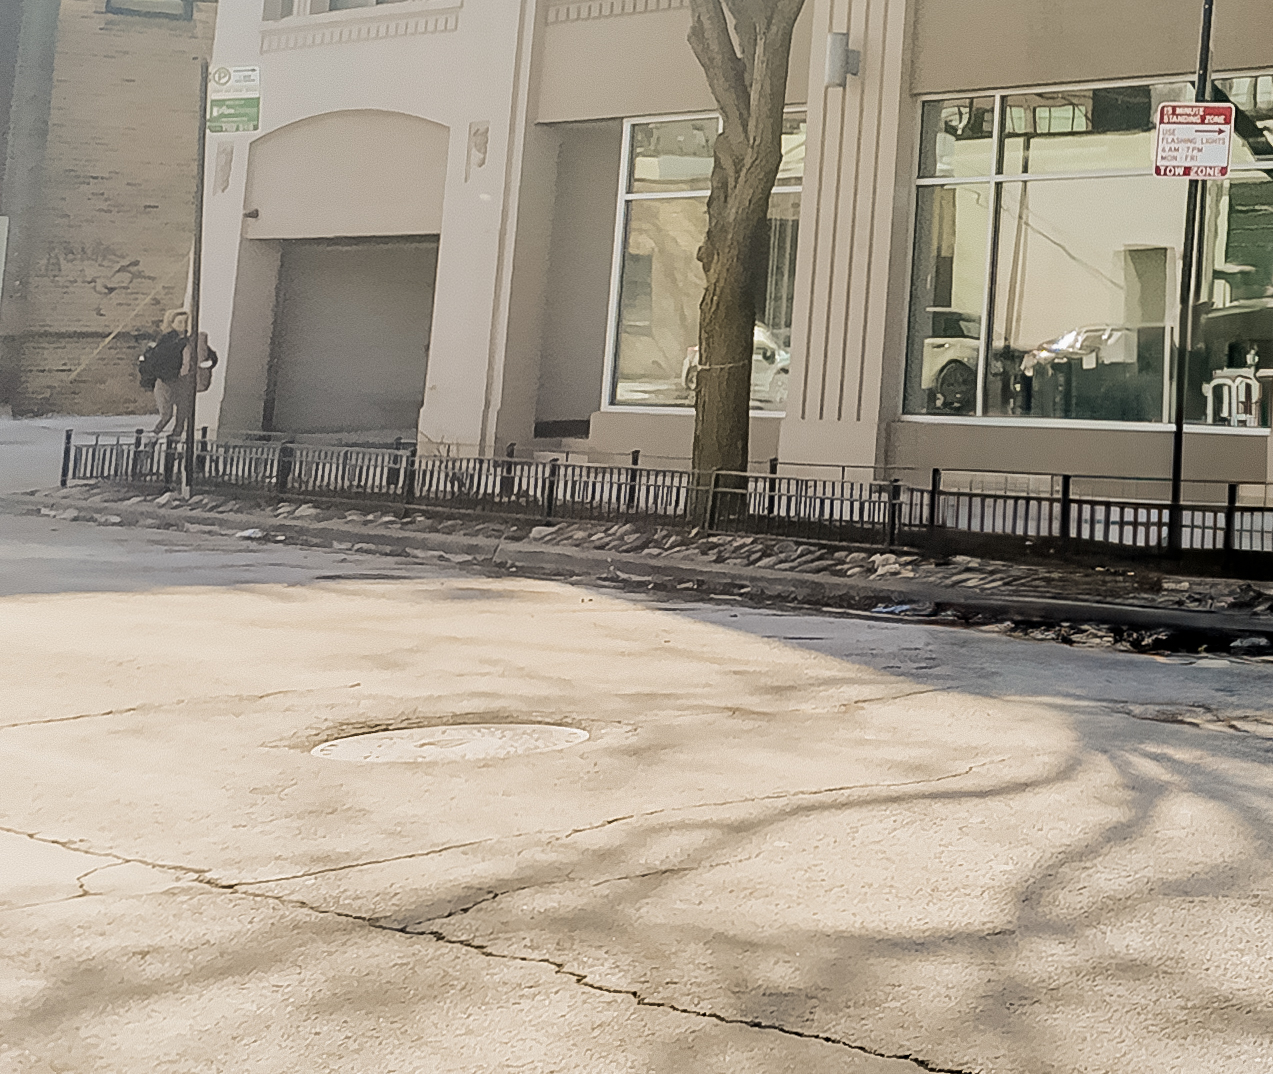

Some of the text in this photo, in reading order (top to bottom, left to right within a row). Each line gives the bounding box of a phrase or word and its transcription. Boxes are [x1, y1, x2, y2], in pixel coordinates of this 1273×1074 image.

[1175, 107, 1205, 115] MINUTE
[1162, 128, 1176, 136] USE
[1161, 137, 1226, 145] FLASHING LIGHTS
[1159, 166, 1222, 177] TOW ZONE
